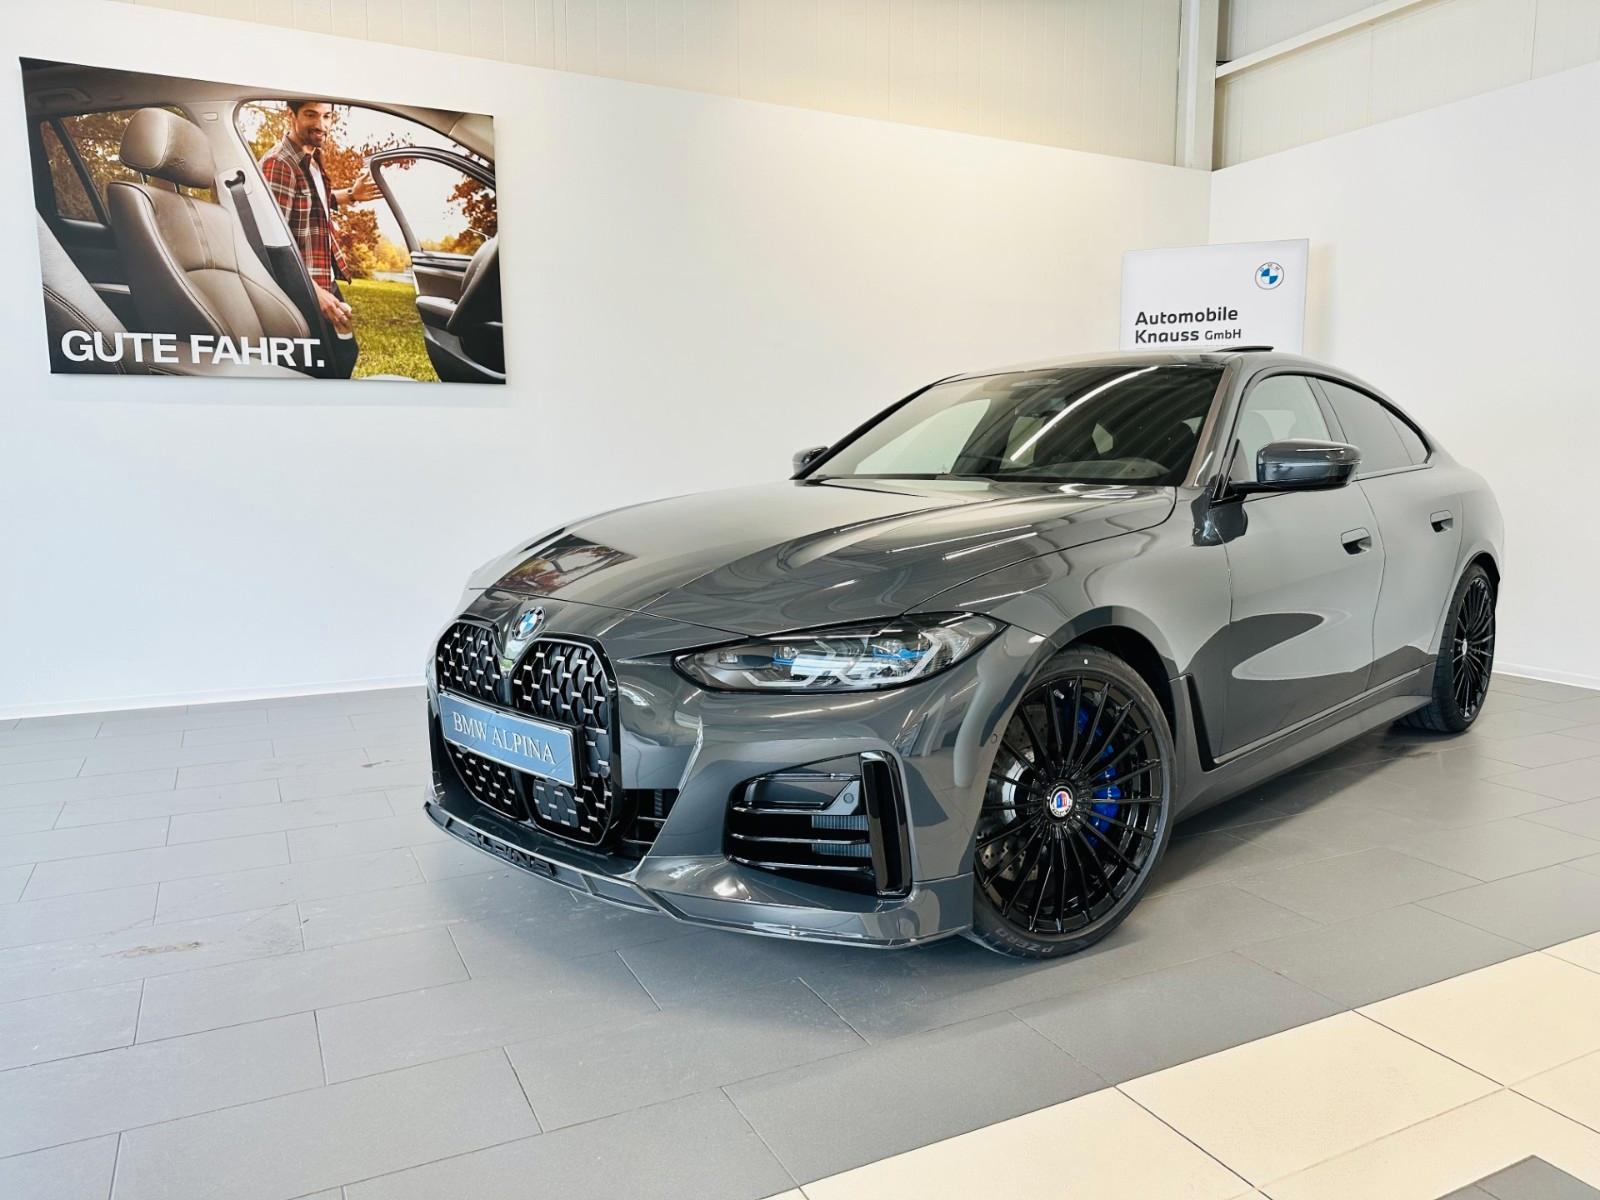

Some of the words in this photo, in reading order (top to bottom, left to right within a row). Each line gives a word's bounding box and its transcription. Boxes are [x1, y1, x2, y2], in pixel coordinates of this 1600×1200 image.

[1135, 306, 1238, 326] Automobile
[61, 330, 179, 363] GUTE
[190, 334, 325, 368] FAHRT.
[1135, 329, 1199, 344] Knauss
[1205, 329, 1241, 340] GmbH
[452, 711, 487, 741] BMW
[492, 728, 556, 764] ALPINA
[465, 832, 554, 877] ALPINA
